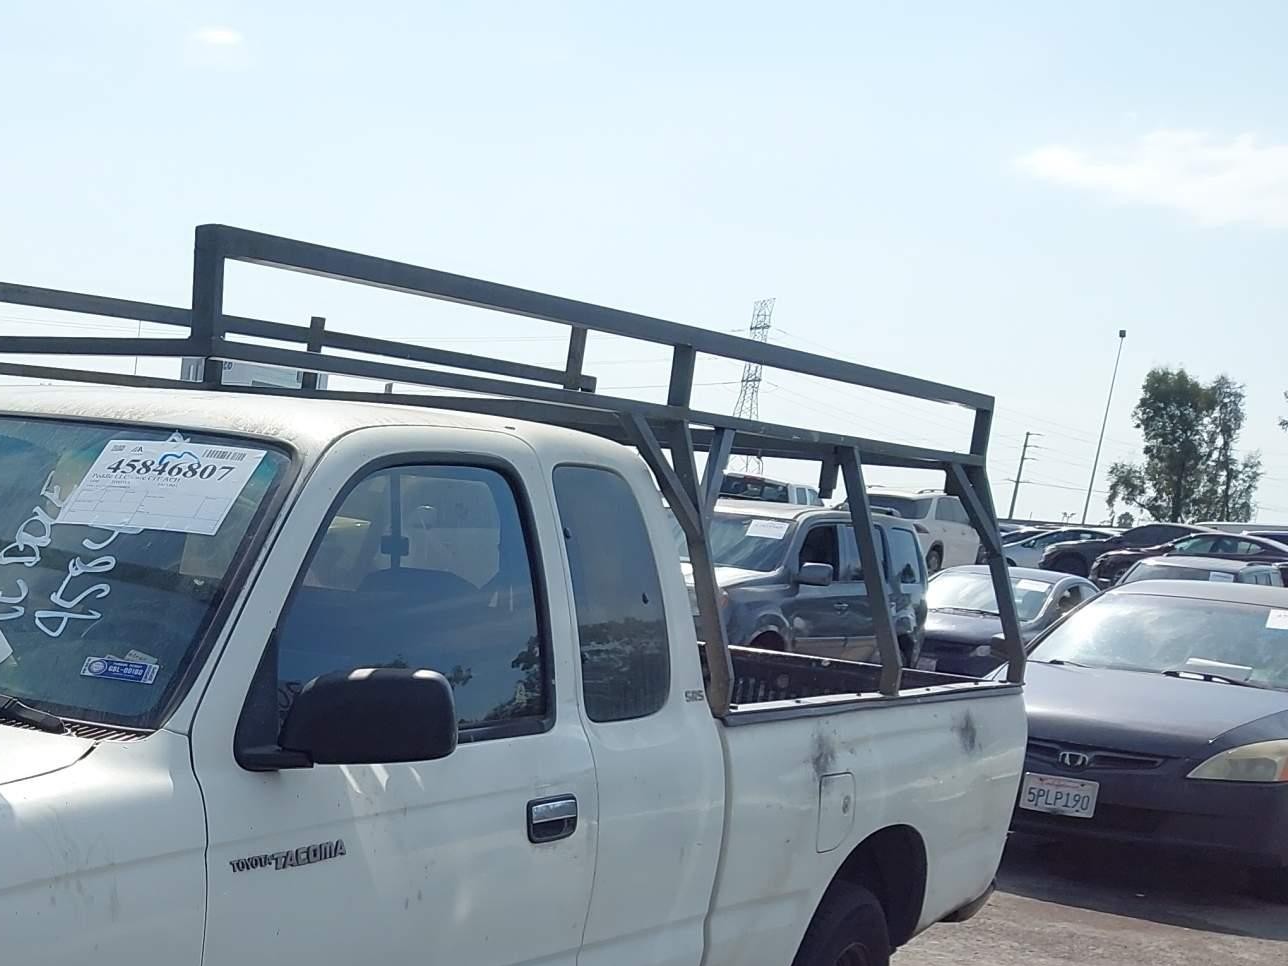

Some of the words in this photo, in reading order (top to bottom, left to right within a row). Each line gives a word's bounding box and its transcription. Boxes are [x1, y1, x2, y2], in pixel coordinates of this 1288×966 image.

[107, 457, 237, 482] 45846807
[1027, 787, 1090, 811] 5PLP190
[229, 854, 273, 873] TOYOTA
[272, 839, 346, 870] TACOMA
